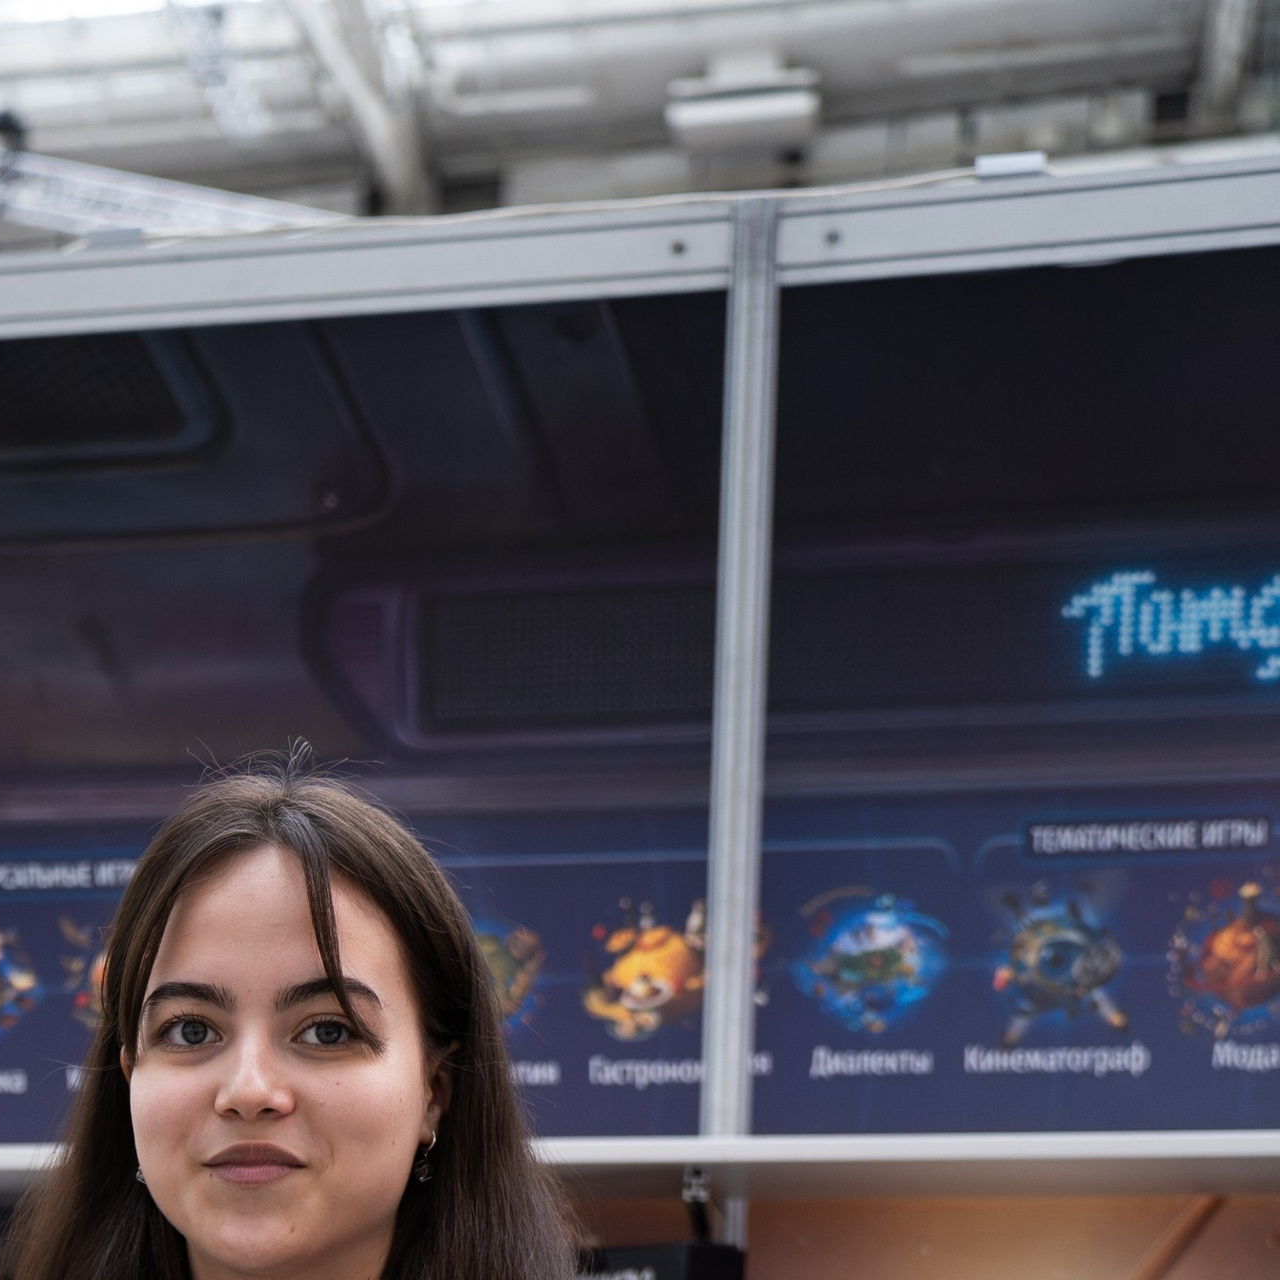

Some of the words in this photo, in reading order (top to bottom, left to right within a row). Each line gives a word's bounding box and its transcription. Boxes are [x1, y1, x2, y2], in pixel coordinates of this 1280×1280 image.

[1201, 818, 1268, 848] ИГРЫ
[809, 1044, 934, 1079] Диалекты
[963, 1039, 1152, 1078] Кинематограф
